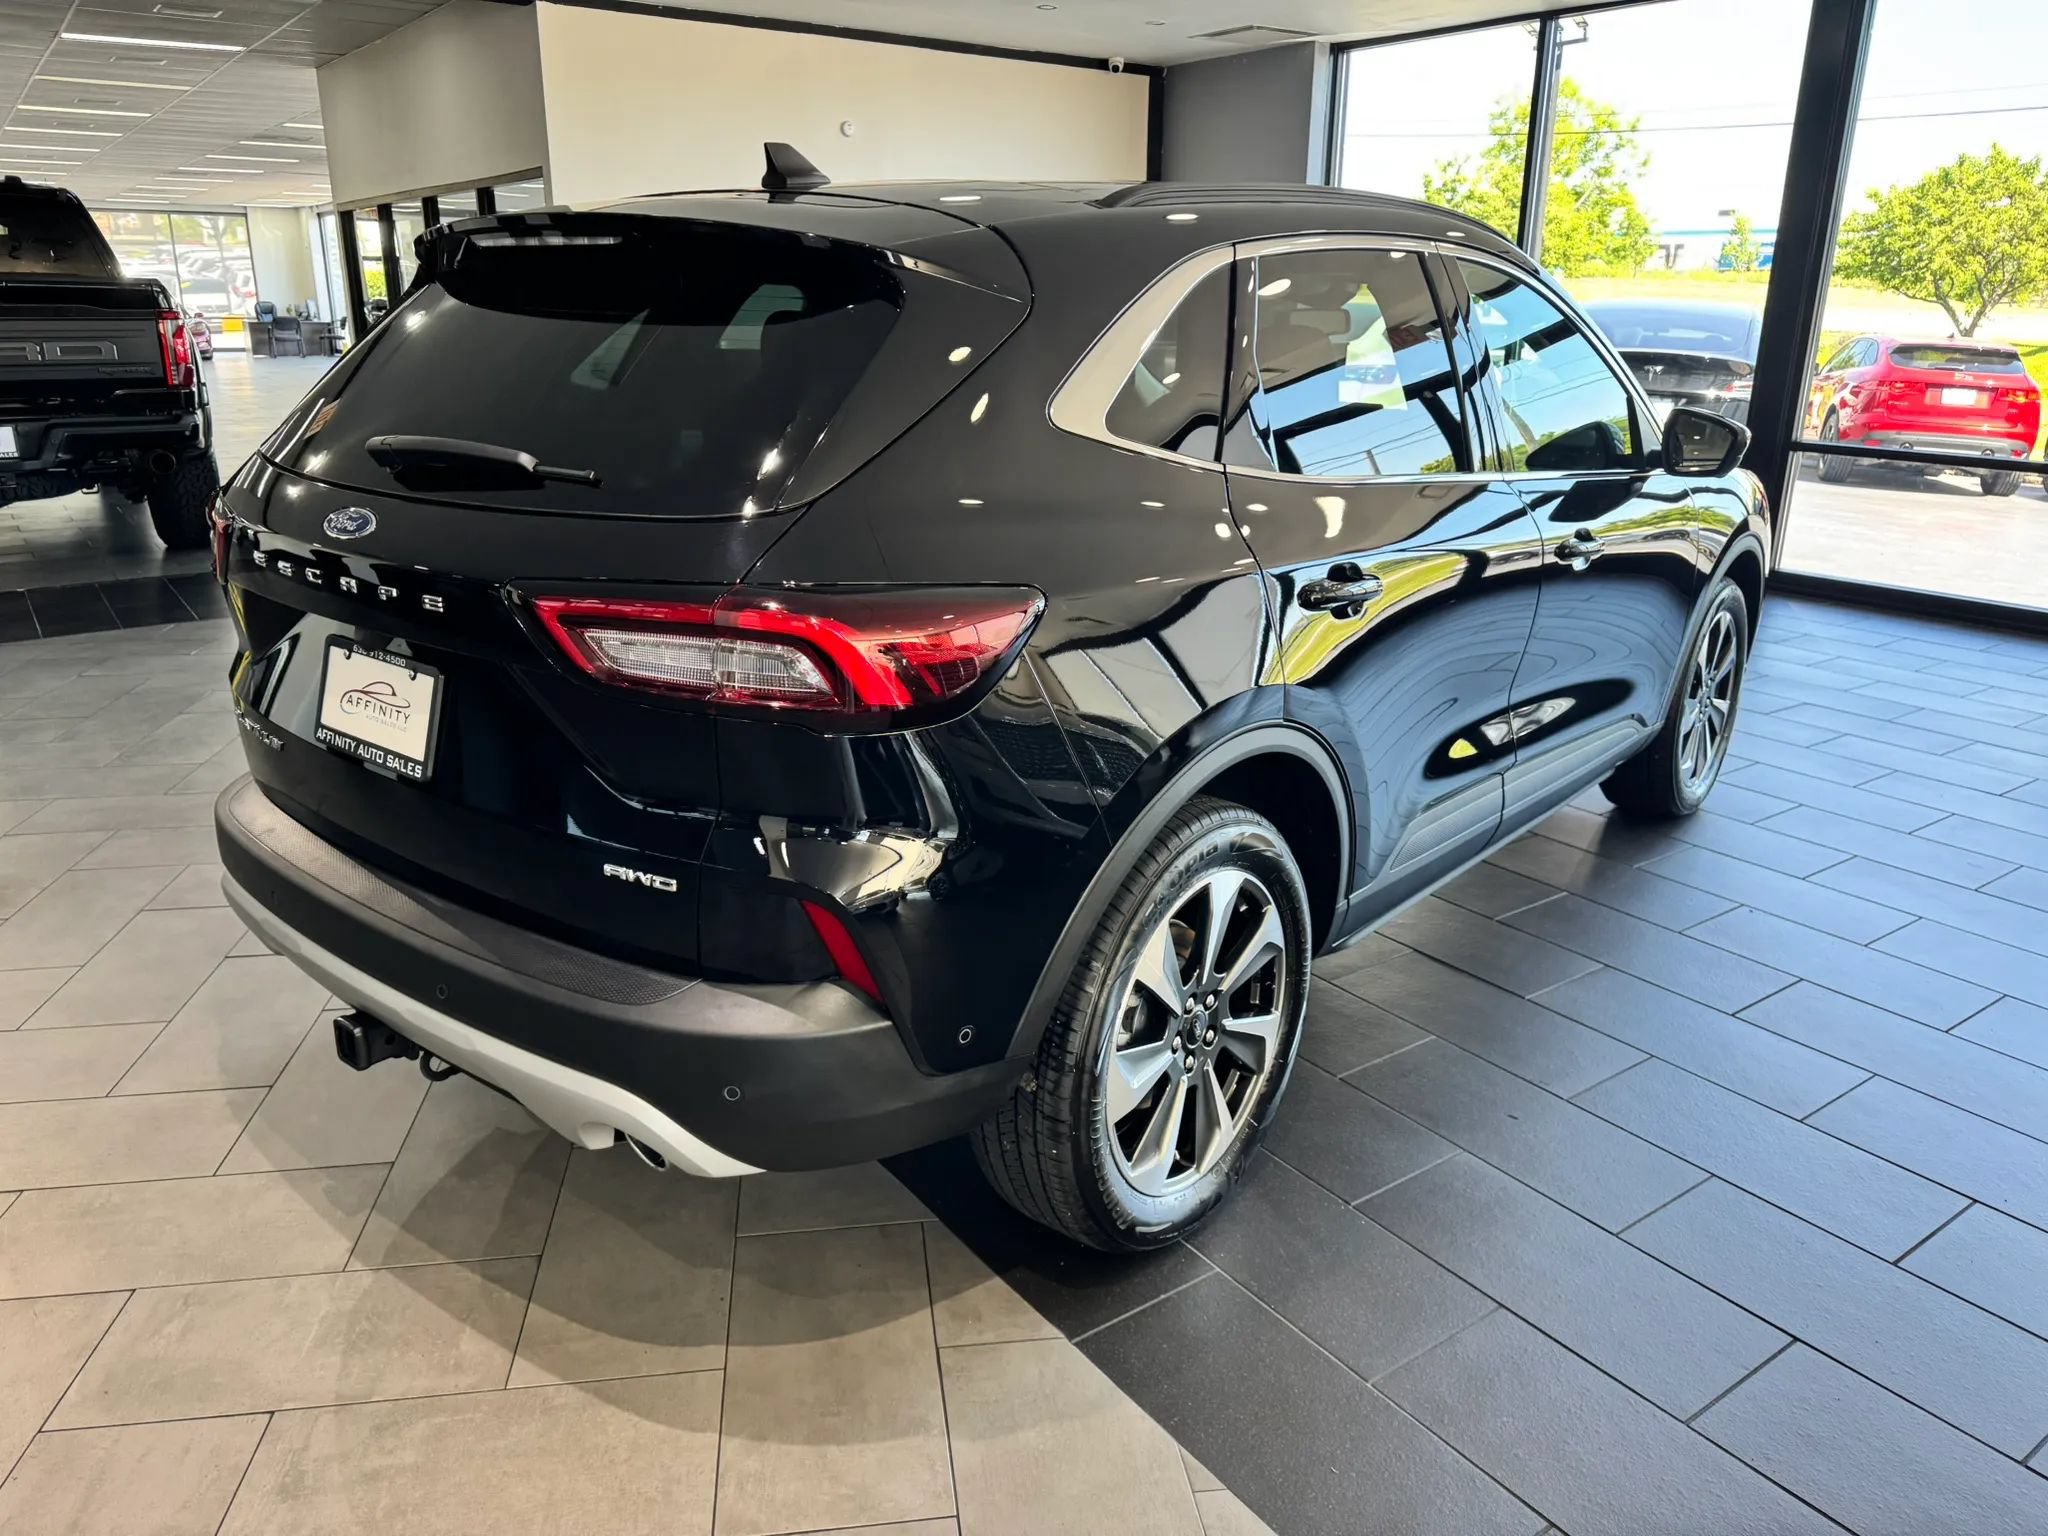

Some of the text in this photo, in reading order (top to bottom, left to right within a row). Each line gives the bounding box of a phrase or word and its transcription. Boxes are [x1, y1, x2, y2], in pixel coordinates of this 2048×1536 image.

[329, 511, 364, 532] Ford
[253, 550, 444, 613] ESCAPE
[345, 694, 412, 725] AFFINITY
[315, 727, 423, 778] AFFINITY AUTO SALES
[603, 863, 677, 892] AWD
